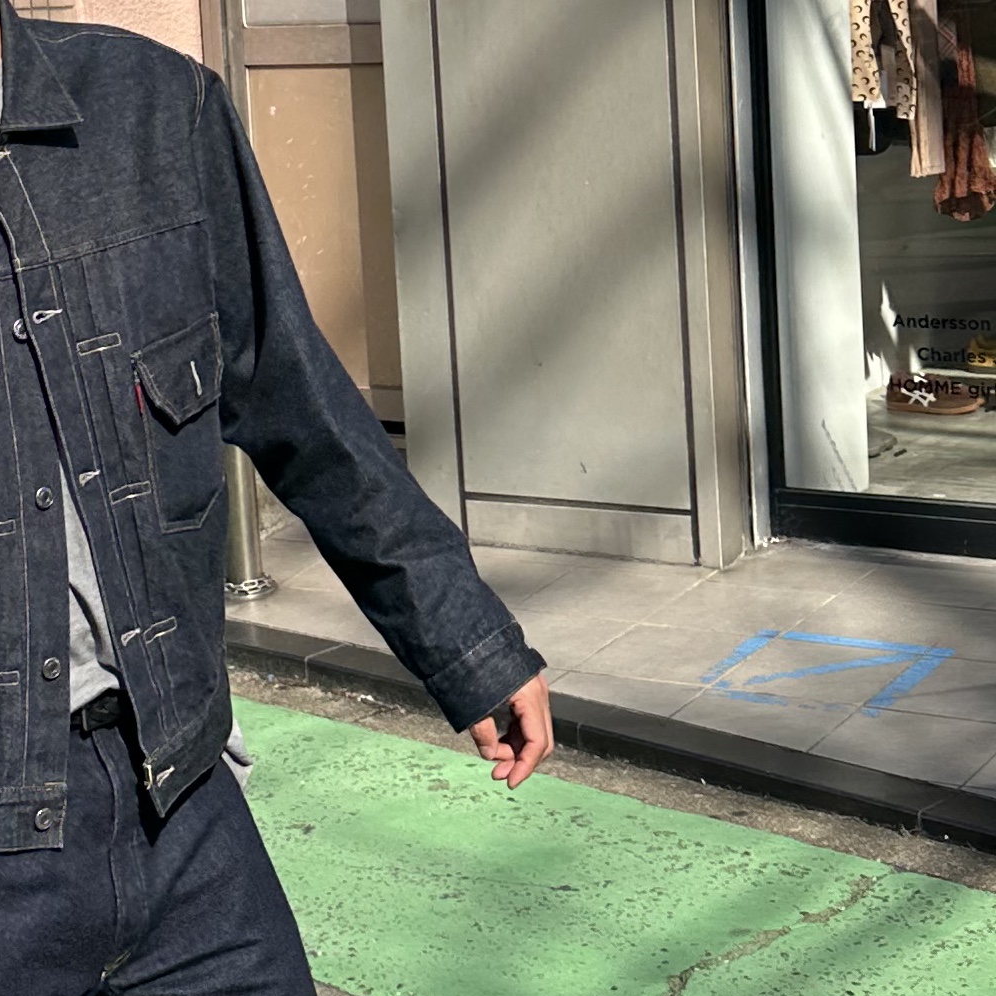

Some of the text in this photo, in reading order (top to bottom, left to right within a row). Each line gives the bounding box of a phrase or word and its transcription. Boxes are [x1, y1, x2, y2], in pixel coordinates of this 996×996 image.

[893, 314, 991, 331] Andersson
[918, 347, 986, 364] Charles
[890, 377, 962, 395] HOMME
